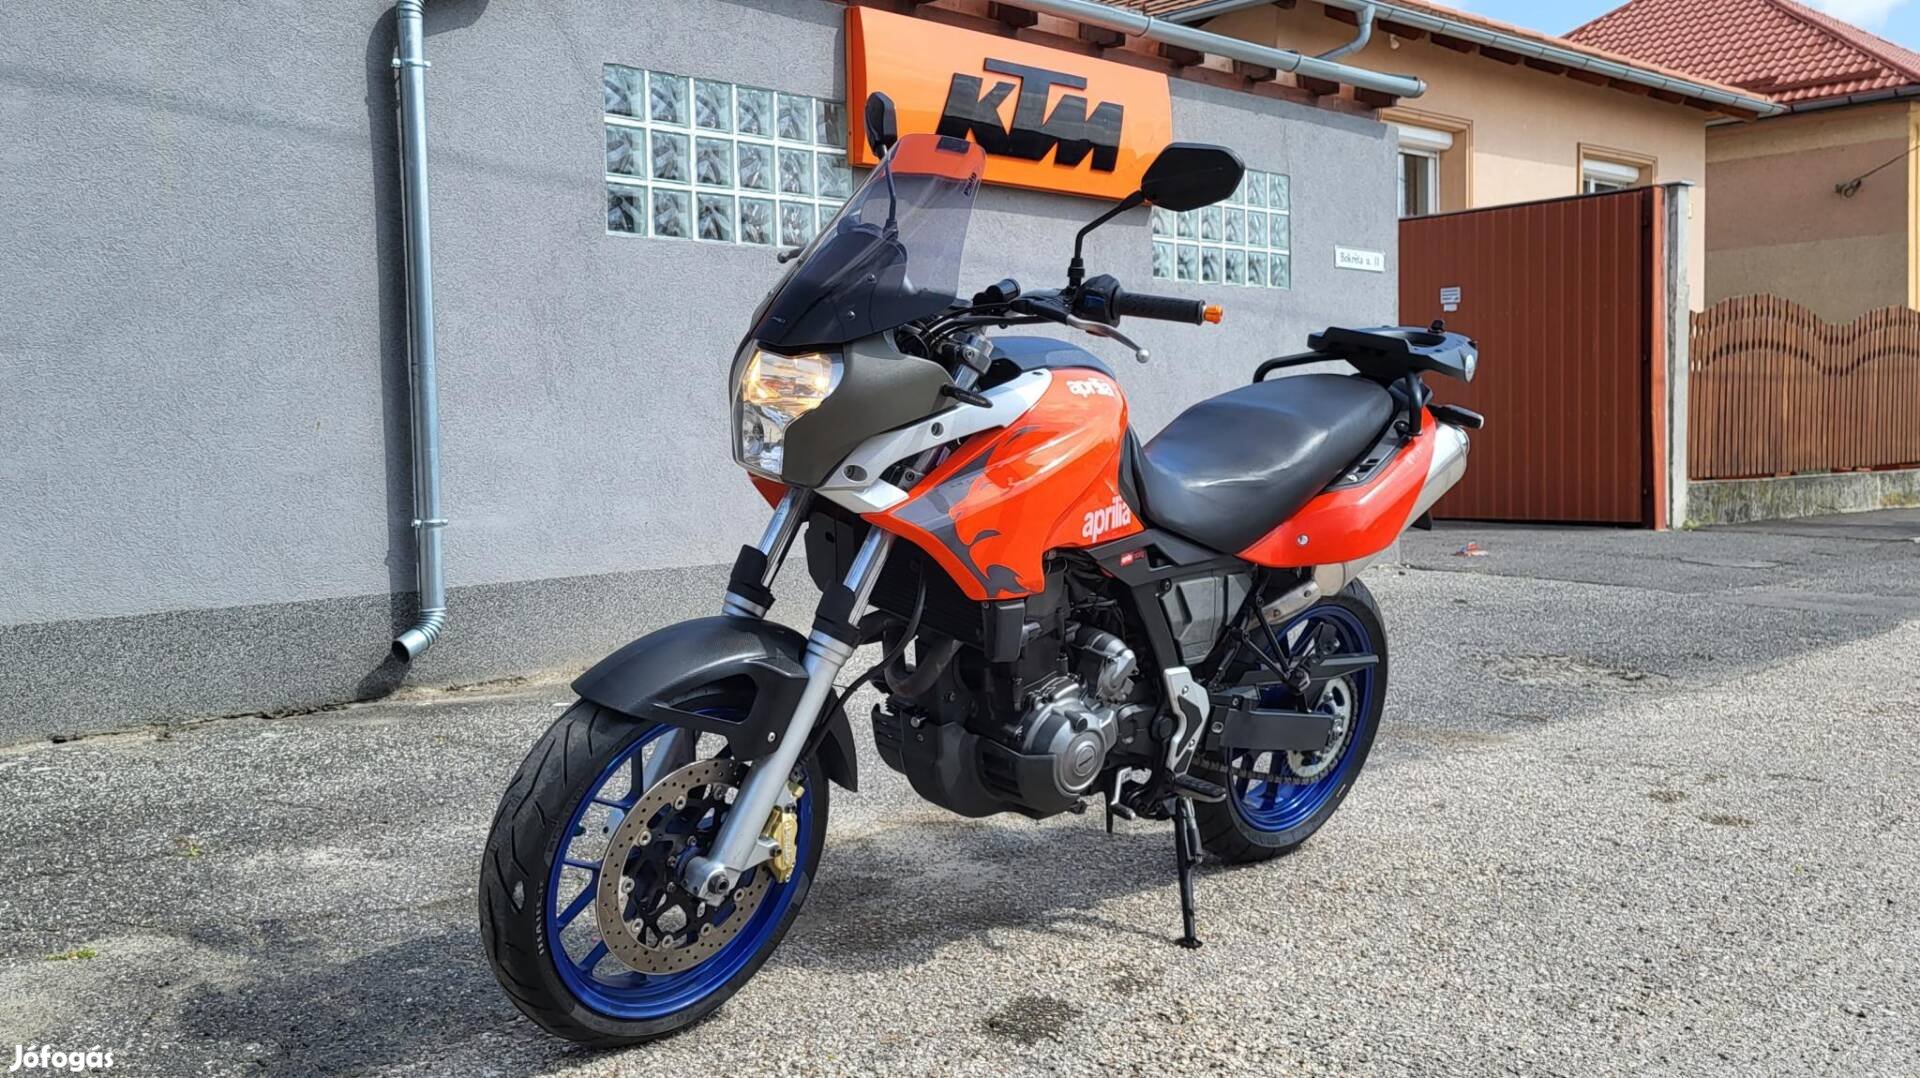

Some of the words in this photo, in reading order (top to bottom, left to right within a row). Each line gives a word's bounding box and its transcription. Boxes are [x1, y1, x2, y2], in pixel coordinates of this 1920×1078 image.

[935, 57, 1124, 173] KTM
[1066, 377, 1115, 398] aprilia
[1081, 495, 1131, 544] aprilia
